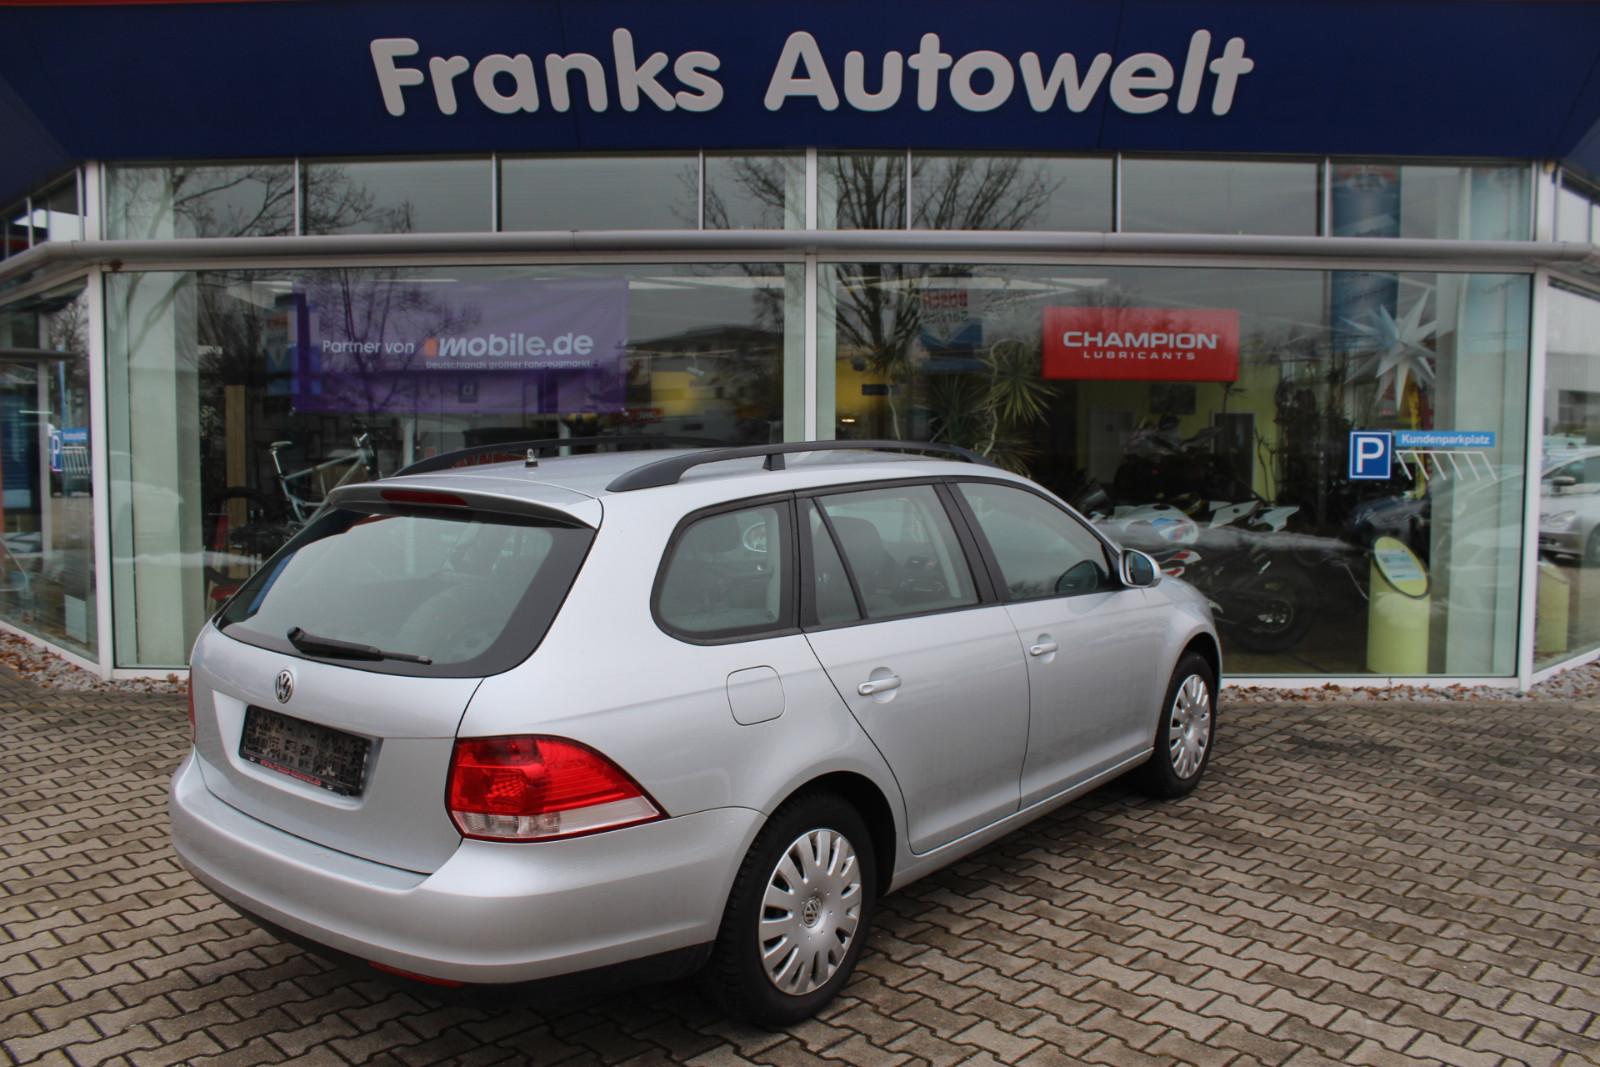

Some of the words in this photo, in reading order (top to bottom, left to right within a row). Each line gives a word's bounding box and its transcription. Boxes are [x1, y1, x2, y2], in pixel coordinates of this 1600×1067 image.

[370, 28, 724, 117] Franks
[764, 29, 1254, 117] Autowelt
[322, 339, 381, 354] Partner
[385, 343, 414, 354] von
[437, 332, 594, 357] mobile.de
[1063, 331, 1217, 350] CHAMPION
[1083, 351, 1196, 361] LUBRICANTS
[1401, 433, 1490, 446] Kundenparkplatz
[1356, 436, 1385, 473] P
